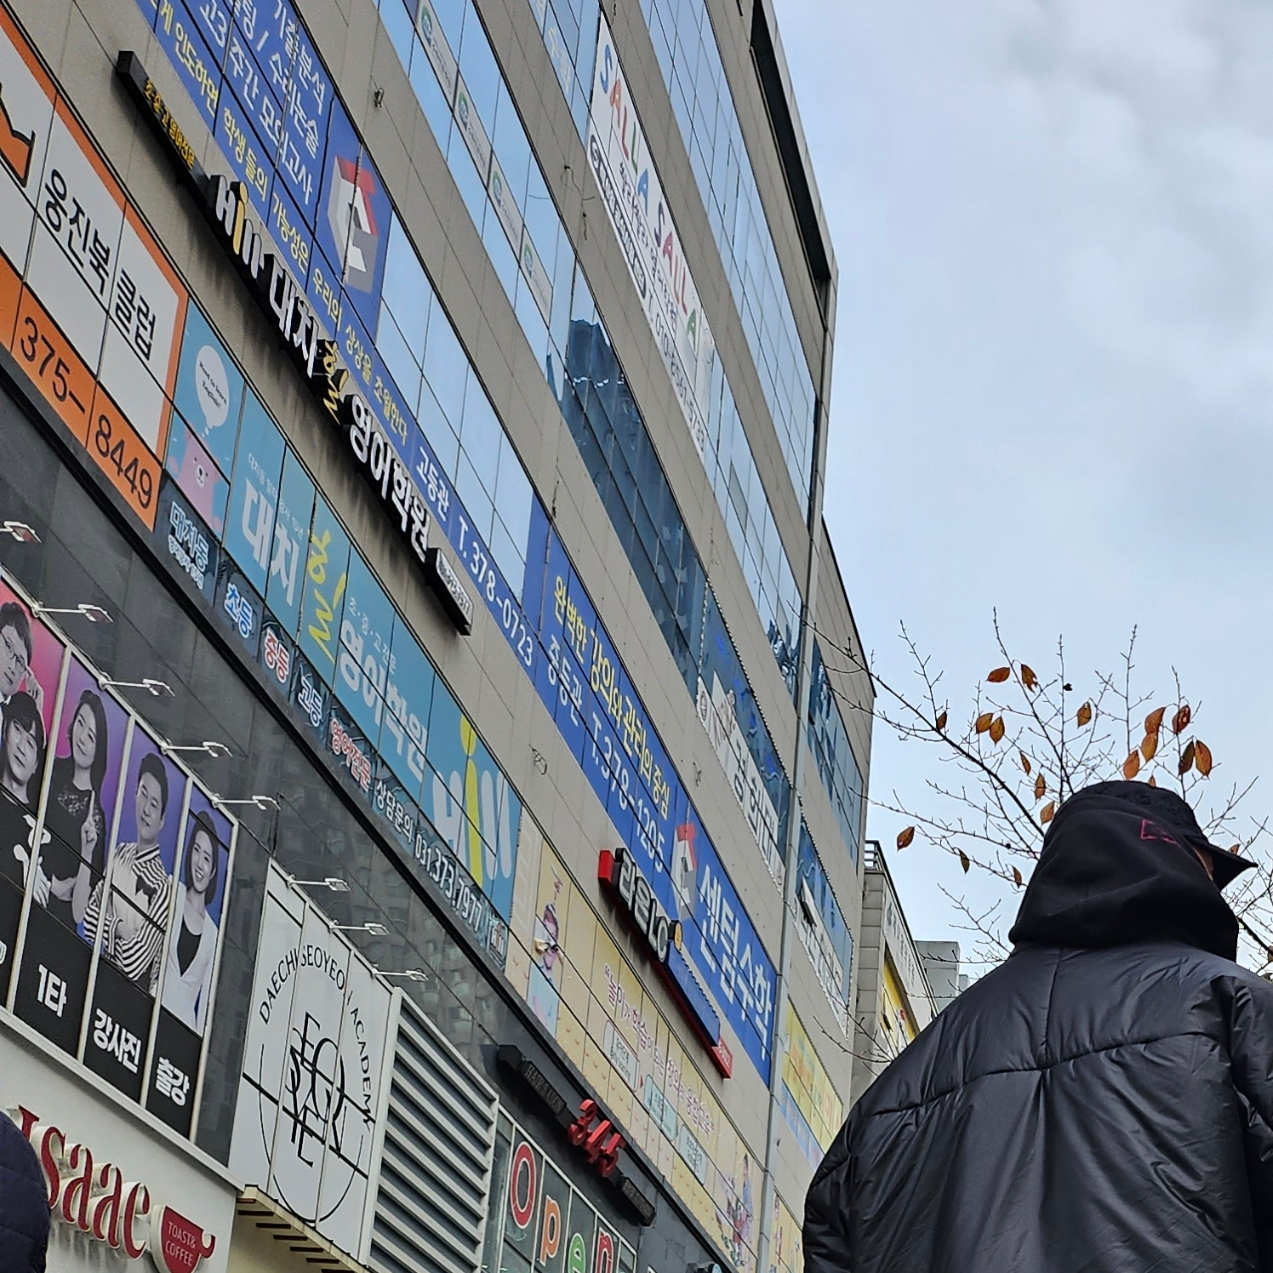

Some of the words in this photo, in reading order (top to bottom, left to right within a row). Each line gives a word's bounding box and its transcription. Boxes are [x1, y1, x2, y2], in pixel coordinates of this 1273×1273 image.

[230, 37, 259, 110] 주간
[259, 95, 313, 206] 모의고사
[600, 44, 649, 216] SALLA
[653, 201, 698, 350] SALLA
[175, 23, 219, 117] 인도하면
[224, 107, 268, 202] 학생들의
[272, 194, 311, 276] 가능성은
[313, 268, 343, 332] 우리의
[345, 323, 374, 386] 상상을
[373, 374, 410, 443] 초월한다
[270, 256, 320, 378] 대치
[351, 394, 431, 558] 영어학원
[415, 447, 451, 515] 고등관
[170, 500, 210, 572] 대치동
[224, 582, 253, 639] 초등
[264, 629, 290, 684] 중등
[298, 675, 324, 728] 고등
[330, 718, 373, 794] 영어전문
[375, 779, 415, 845] 상담문의
[242, 487, 299, 608] 대치
[339, 619, 429, 784] 영어학원
[547, 633, 584, 726] 중등관
[553, 573, 588, 664] 완벽한
[588, 626, 624, 717] 강의와
[622, 699, 655, 789] 관리의
[650, 750, 672, 820] 중심
[36, 963, 68, 1018] 1타
[94, 1008, 143, 1074] 강사진
[155, 1055, 190, 1107] 출강
[259, 946, 299, 1026] DAECHI
[350, 1006, 382, 1133] ACADEMY
[699, 862, 773, 1063] 센텀수학
[164, 1239, 195, 1267] COFFEE
